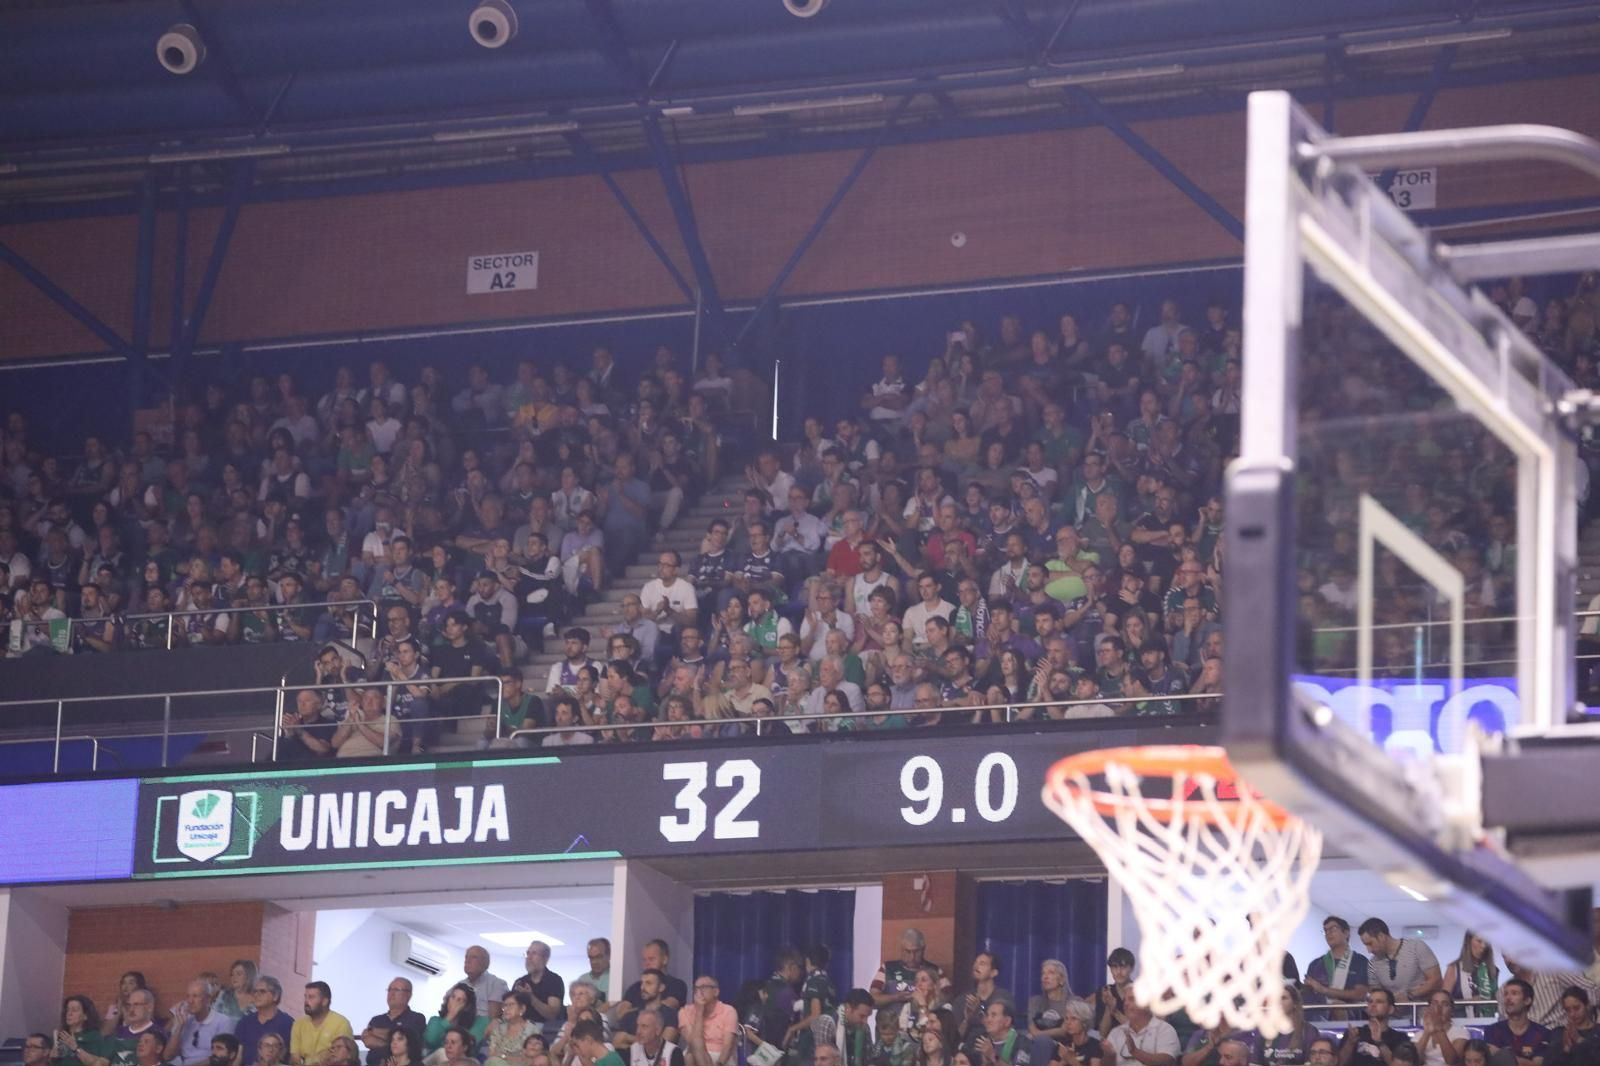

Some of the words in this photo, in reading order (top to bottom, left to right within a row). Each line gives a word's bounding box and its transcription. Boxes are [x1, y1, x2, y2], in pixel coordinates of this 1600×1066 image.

[473, 254, 534, 270] SECTOR
[490, 271, 516, 290] A2
[280, 784, 510, 851] UNICAJA
[660, 759, 761, 842] 32
[900, 752, 1019, 825] 9.0
